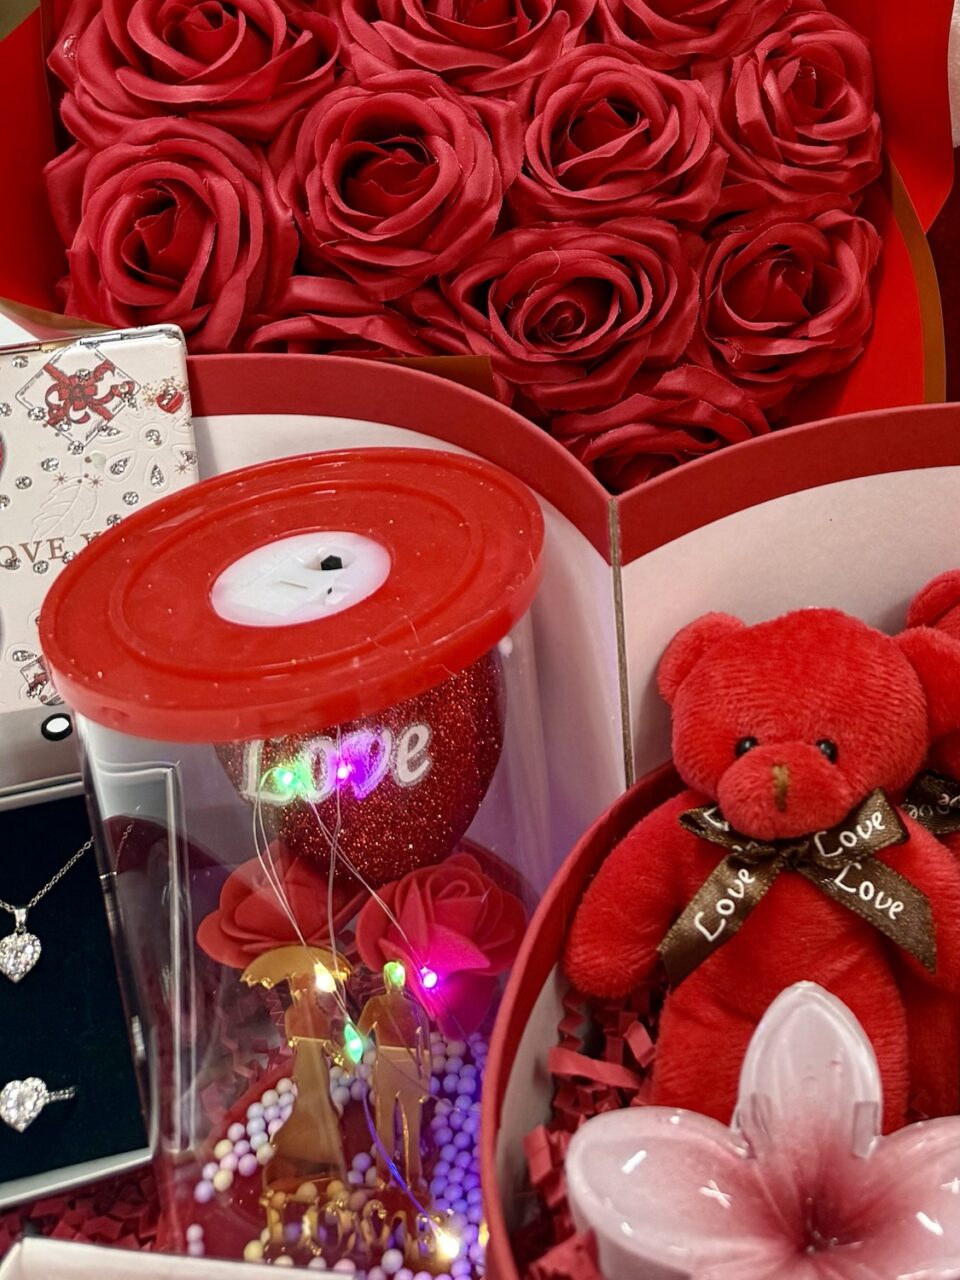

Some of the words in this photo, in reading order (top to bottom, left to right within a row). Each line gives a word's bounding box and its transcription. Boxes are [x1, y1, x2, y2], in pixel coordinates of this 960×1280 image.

[240, 722, 432, 806] Love
[814, 811, 886, 857] Love
[694, 868, 756, 942] Love
[834, 862, 904, 920] Love
